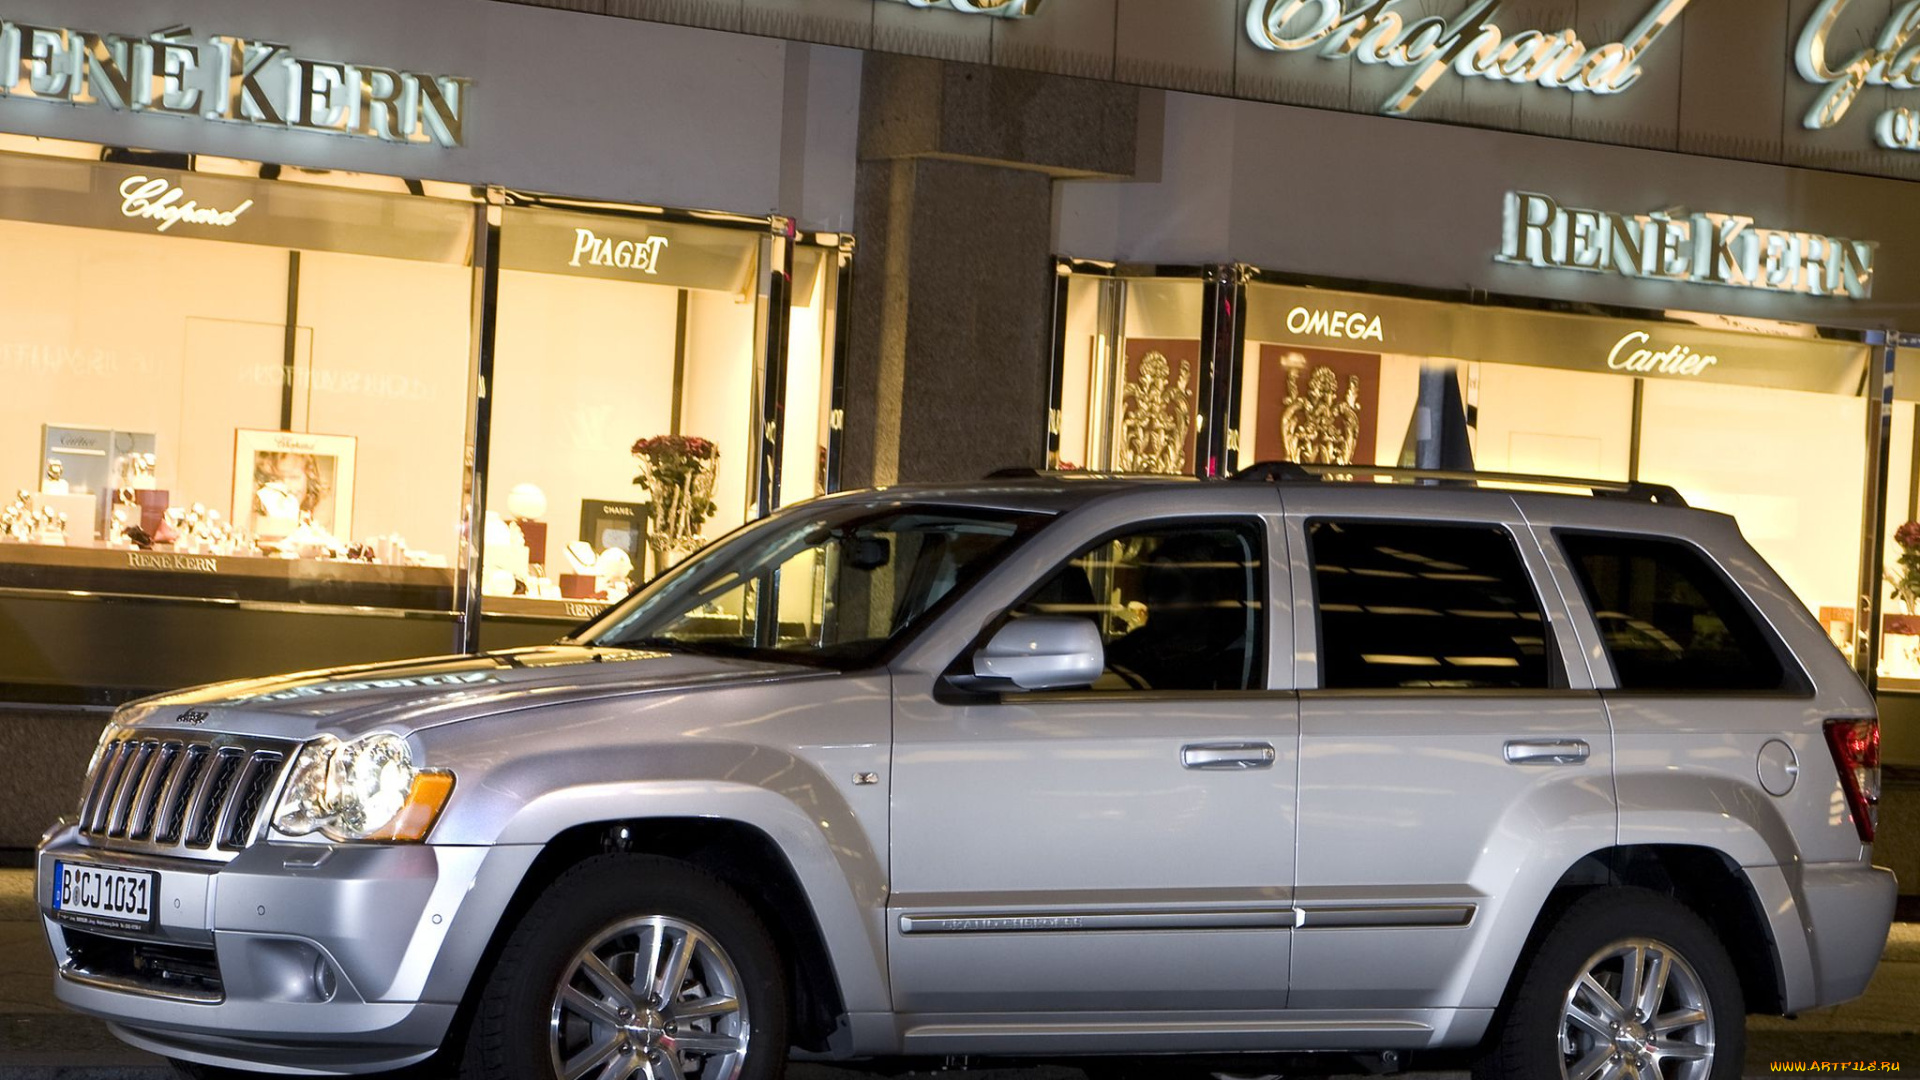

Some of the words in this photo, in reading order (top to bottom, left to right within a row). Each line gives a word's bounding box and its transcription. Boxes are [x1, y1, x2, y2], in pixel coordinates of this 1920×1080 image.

[0, 20, 203, 118] ENÉ
[205, 35, 475, 148] KERN
[119, 175, 254, 232] Chopard
[568, 228, 669, 275] PIAGET
[1688, 212, 1880, 300] KERN
[1286, 306, 1384, 342] OMEGA
[1607, 331, 1718, 375] Cartier
[603, 505, 635, 516] CHANEL
[172, 554, 218, 573] KERN
[62, 869, 72, 905] B
[103, 875, 148, 915] 1031
